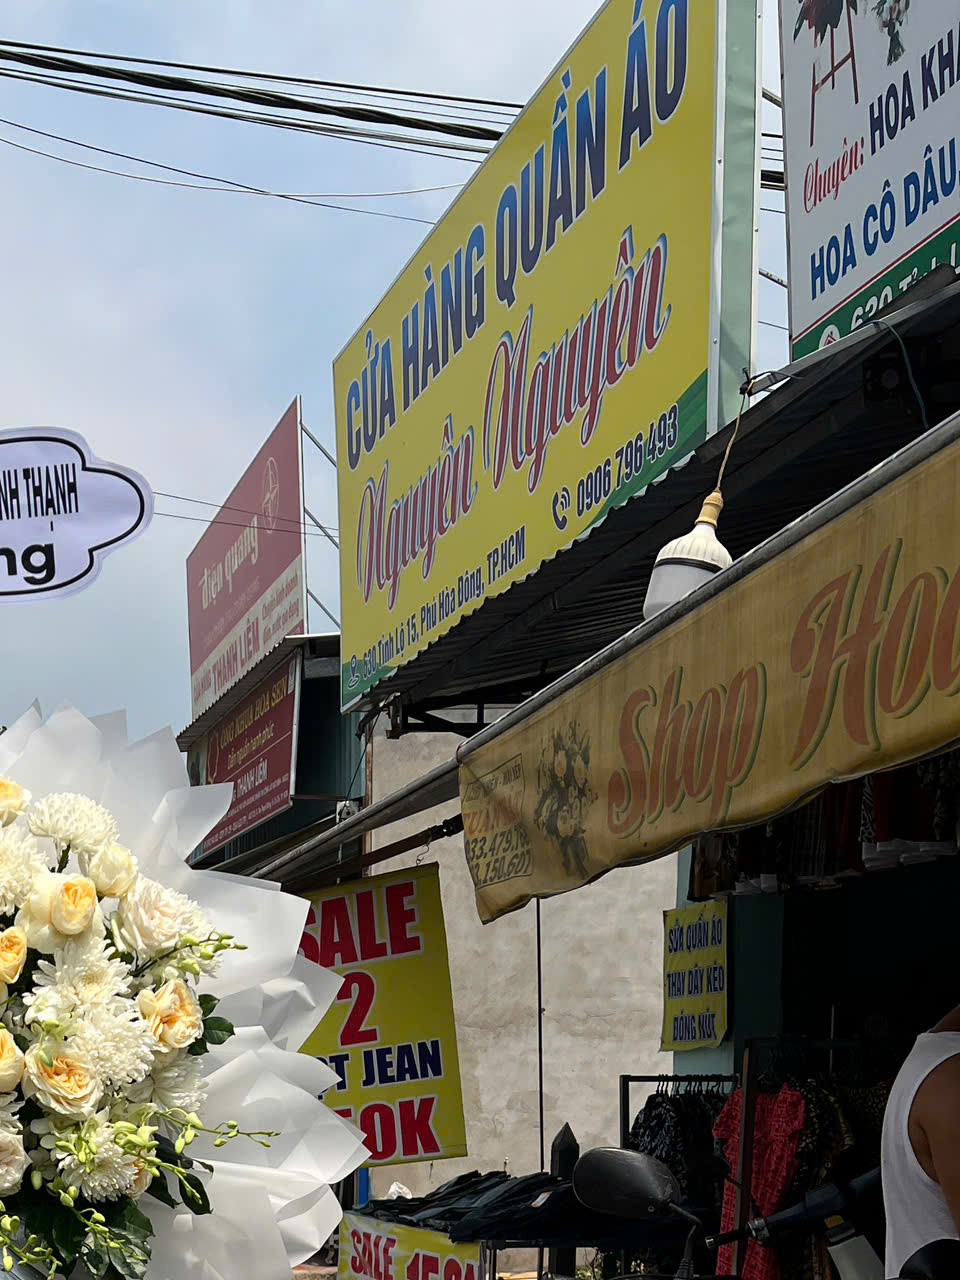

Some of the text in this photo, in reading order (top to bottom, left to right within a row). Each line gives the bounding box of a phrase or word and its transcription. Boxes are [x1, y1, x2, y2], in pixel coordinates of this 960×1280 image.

[869, 70, 915, 156] HOA
[803, 136, 865, 214] Chuyên:
[346, 0, 690, 471] CỬA HÀNG QUẦN ÁO
[810, 223, 857, 300] HOA
[862, 179, 896, 257] CÔ
[23, 463, 79, 532] THẠNH
[576, 404, 678, 518] 0906 796 493
[198, 562, 223, 610] điện
[224, 514, 259, 593] quang
[395, 622, 405, 658] Lộ
[407, 613, 419, 647] 15,
[421, 594, 437, 636] Phú
[439, 585, 456, 623] Hòa
[458, 566, 485, 608] Đông,
[487, 526, 526, 585] TP.HCM
[212, 640, 238, 695] THANH
[271, 675, 288, 708] SEN
[608, 663, 767, 838] Shop
[298, 881, 421, 968] SALE
[669, 918, 683, 953] SỬA
[711, 914, 722, 946] ÁO
[337, 971, 378, 1046] 2
[667, 971, 685, 997] THAY
[707, 961, 725, 993] KÉO
[698, 1008, 717, 1041] NÚT
[362, 1040, 443, 1087] JEAN
[336, 1097, 440, 1161] 0K
